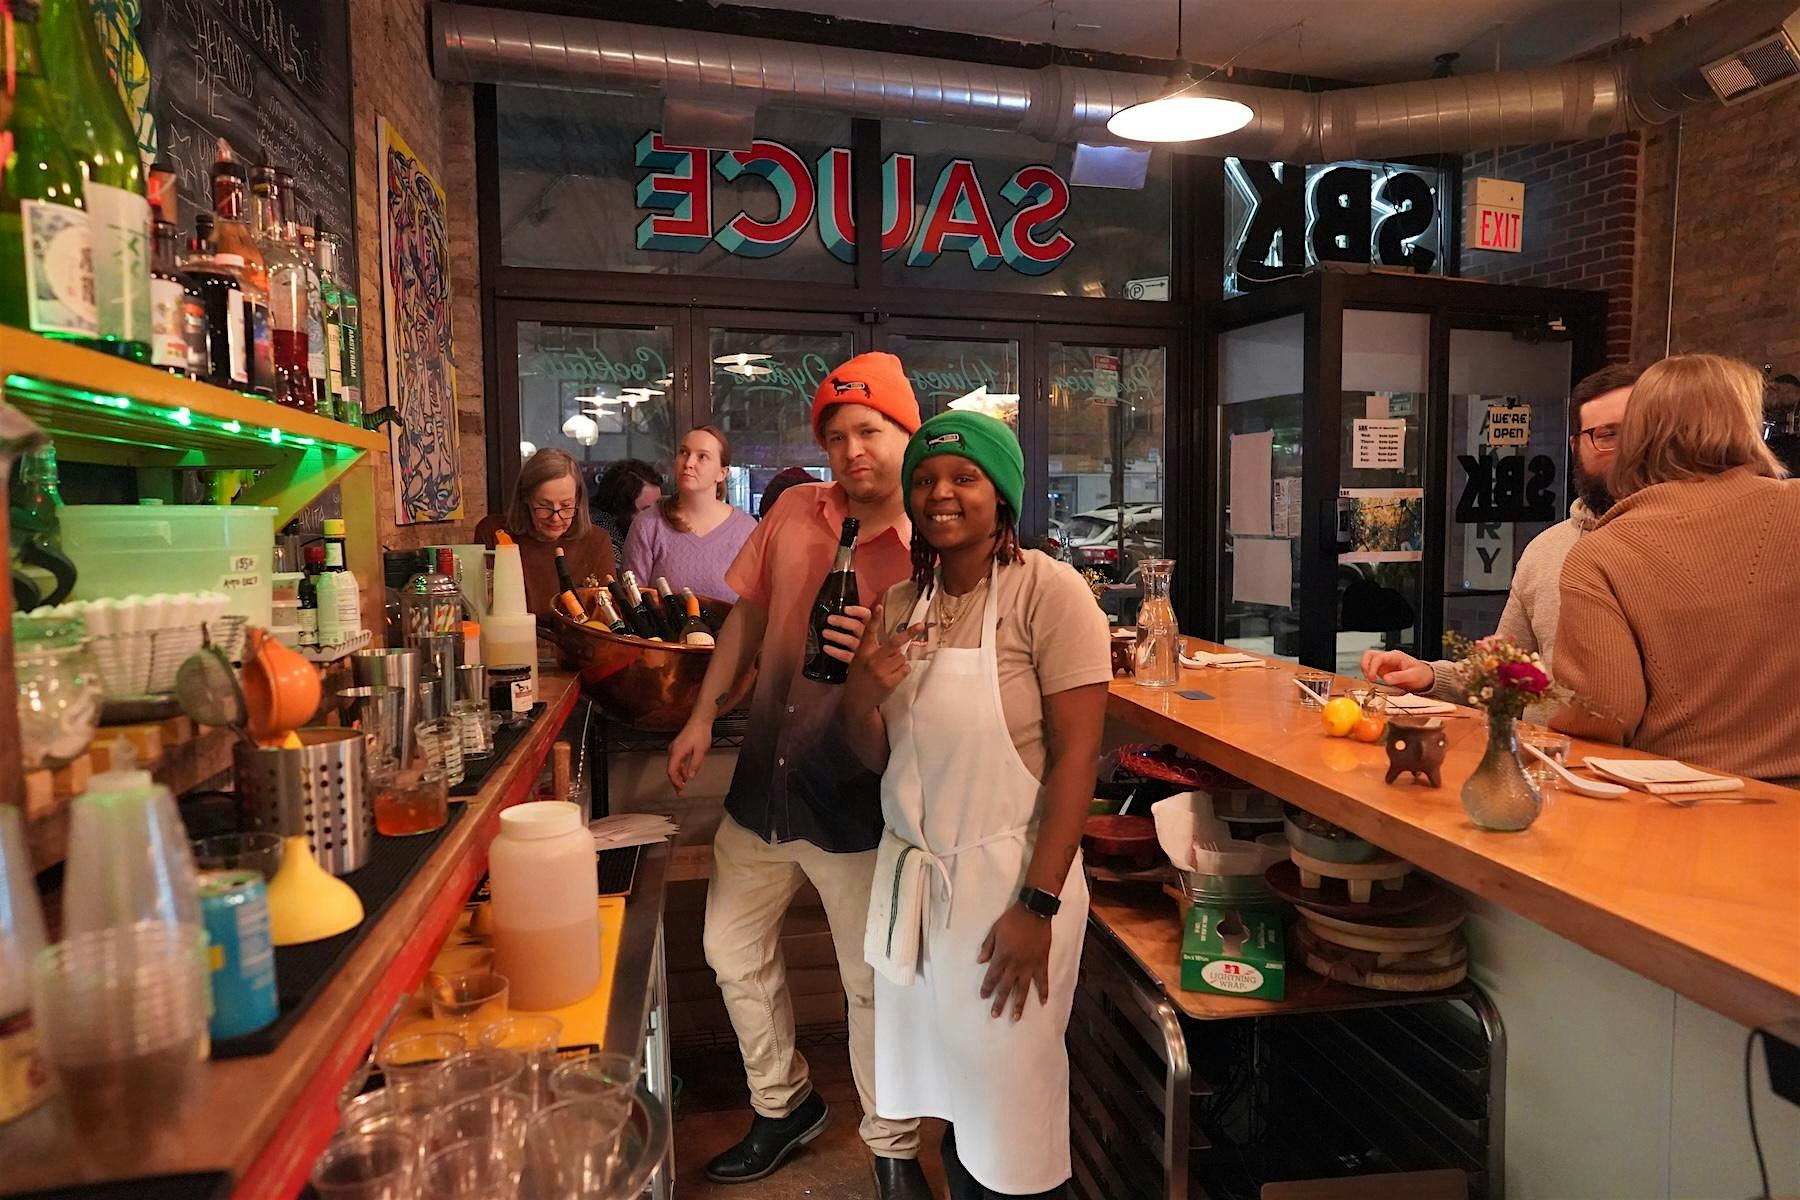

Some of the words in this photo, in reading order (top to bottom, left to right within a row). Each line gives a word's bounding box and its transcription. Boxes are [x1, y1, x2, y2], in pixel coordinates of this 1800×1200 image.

[194, 54, 232, 122] PIE
[1481, 210, 1520, 249] EXIT
[348, 328, 357, 378] AMSTERDAM
[1491, 413, 1528, 424] WE'RE
[1493, 428, 1524, 438] OPEN
[1210, 972, 1257, 983] LIGHTNING
